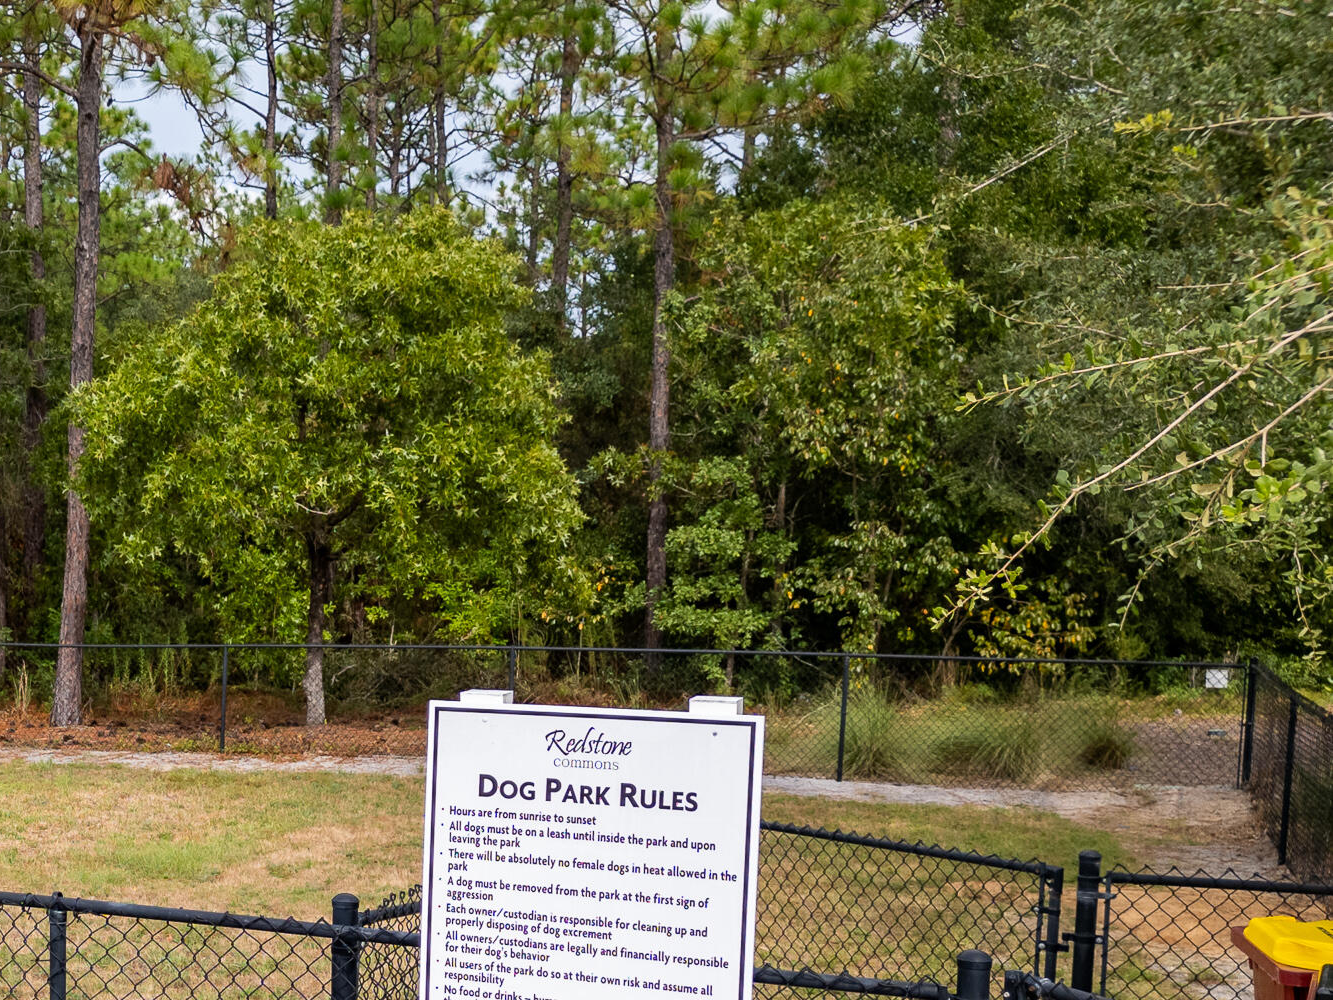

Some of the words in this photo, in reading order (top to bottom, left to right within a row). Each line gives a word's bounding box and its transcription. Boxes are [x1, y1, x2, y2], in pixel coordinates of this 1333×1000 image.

[545, 726, 632, 756] Redstone
[553, 757, 619, 771] commons
[449, 805, 476, 817] Hours
[478, 810, 492, 818] are
[494, 807, 517, 819] from
[519, 812, 551, 822] sunrise
[554, 814, 564, 823] to
[566, 816, 596, 826] sunset
[449, 820, 462, 831] All
[464, 821, 485, 836] dogs
[487, 826, 510, 835] must
[512, 824, 523, 836] be
[525, 829, 537, 837] on
[547, 827, 571, 839] leash
[573, 830, 595, 842] until
[597, 832, 625, 844] inside
[627, 833, 644, 845] the
[646, 836, 668, 849] park
[670, 838, 688, 849] and
[691, 842, 716, 853] upon
[449, 832, 480, 848] leaving
[482, 835, 498, 846] the
[500, 837, 520, 849] park
[448, 848, 474, 860] There
[476, 850, 493, 861] will
[495, 851, 506, 862] be
[508, 853, 556, 869] absolutely
[558, 860, 570, 868] no
[572, 857, 605, 871] female
[607, 860, 629, 876] dogs
[632, 866, 641, 874] in
[643, 863, 665, 876] heat
[667, 865, 706, 879] allowed
[709, 869, 718, 880] in
[720, 870, 737, 882] the
[448, 860, 468, 873] park
[447, 876, 454, 885] A
[456, 876, 473, 890] dog
[475, 880, 497, 889] must
[499, 879, 511, 891] be
[513, 884, 553, 894] removed
[555, 884, 579, 896] from
[581, 886, 597, 898] the
[598, 889, 620, 902] park
[622, 893, 633, 901] at
[635, 891, 651, 903] the
[653, 893, 674, 905] first
[676, 896, 696, 910] sign
[698, 897, 709, 908] of
[447, 890, 493, 901] aggression
[445, 917, 484, 931] properly
[486, 918, 529, 935] disposing
[531, 922, 541, 933] of
[543, 924, 560, 939] dog
[562, 928, 612, 940] excrement
[446, 903, 466, 914] Each
[468, 907, 548, 922] owner/custodian
[550, 915, 557, 923] is
[560, 916, 613, 928] responsible
[615, 918, 630, 930] for
[632, 920, 672, 937] cleaning
[675, 927, 687, 938] up
[689, 926, 708, 938] and
[445, 930, 458, 941] All
[460, 934, 548, 950] owners/custodians
[550, 943, 565, 952] are
[567, 941, 598, 958] legally
[600, 946, 618, 957] and
[620, 947, 670, 965] financially
[673, 956, 729, 969] responsible
[445, 941, 458, 952] for
[461, 943, 482, 956] their
[484, 946, 508, 959] dog's
[510, 948, 550, 962] behavior
[444, 972, 505, 988] responsibility
[445, 957, 457, 968] All
[459, 961, 482, 971] users
[484, 961, 495, 972] of
[496, 962, 511, 974] the
[513, 965, 534, 977] park
[536, 966, 549, 978] do
[551, 971, 561, 979] so
[563, 971, 573, 980] at
[575, 971, 598, 983] their
[600, 976, 621, 986] own
[623, 977, 640, 988] risk
[642, 979, 660, 990] and
[663, 983, 698, 995] assume
[700, 985, 713, 996] all
[444, 984, 457, 995] No
[459, 985, 480, 997] food
[482, 991, 492, 999] or
